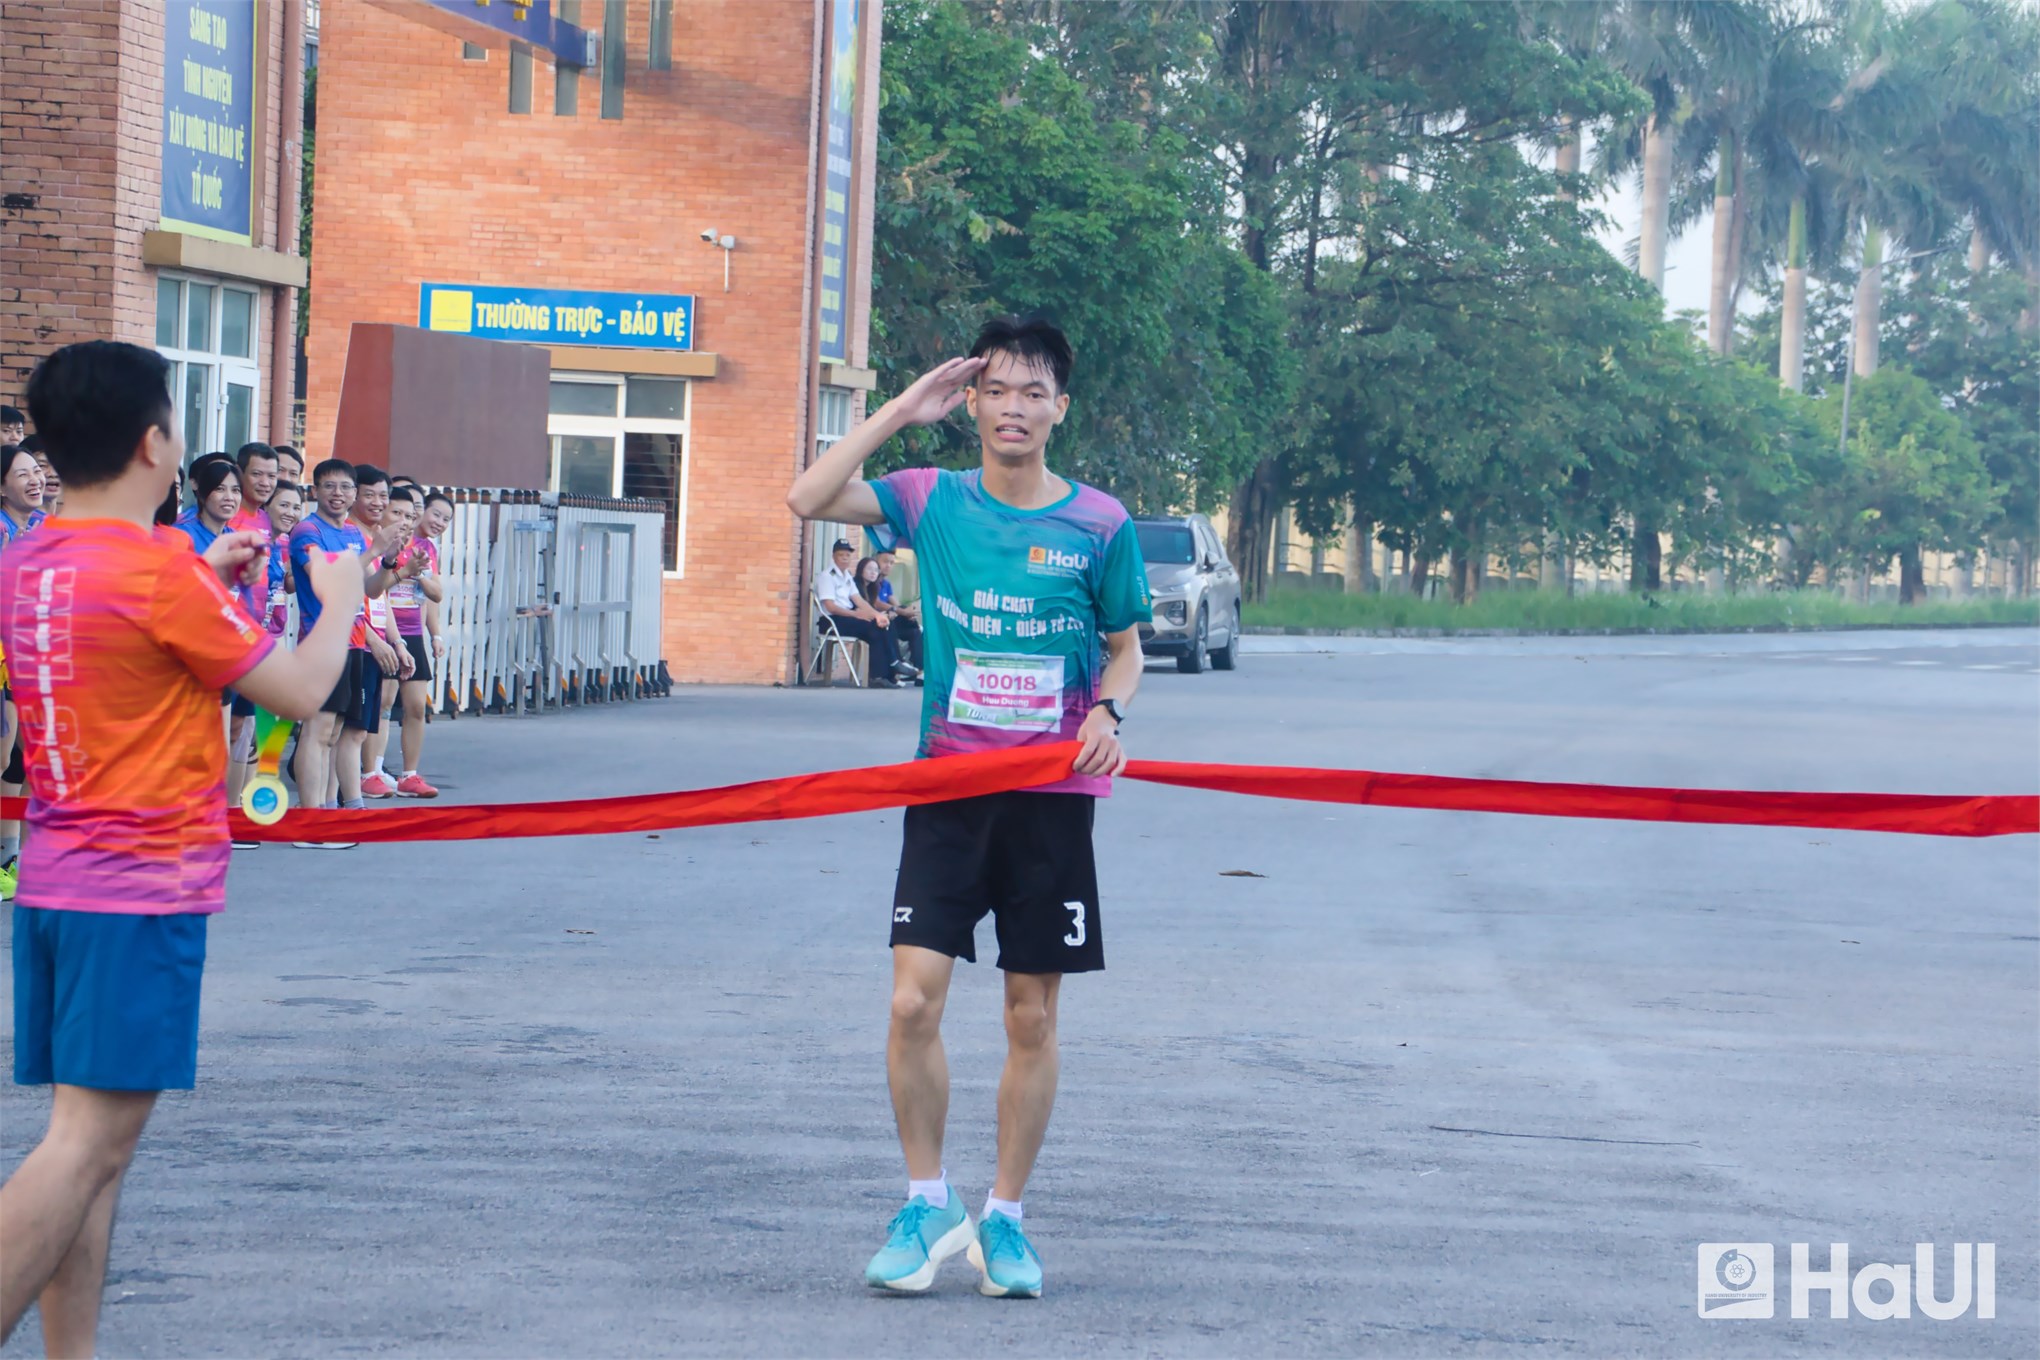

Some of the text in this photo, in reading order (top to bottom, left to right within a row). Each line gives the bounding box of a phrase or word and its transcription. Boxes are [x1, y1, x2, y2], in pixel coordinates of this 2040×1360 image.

[190, 1, 227, 56] SÁNG TẠO
[207, 115, 218, 155] VÀ
[219, 112, 234, 160] BẢO
[235, 124, 245, 169] VỆ
[191, 160, 202, 205] TỔ
[476, 297, 686, 342] THƯỜNG TRỰC - BẢO VỆ
[973, 587, 1035, 618] GIẢI CHẠY
[971, 614, 1002, 640] ĐIỆN
[1016, 617, 1047, 640] ĐIỆN
[976, 673, 1037, 691] 10018
[1063, 901, 1086, 946] 3
